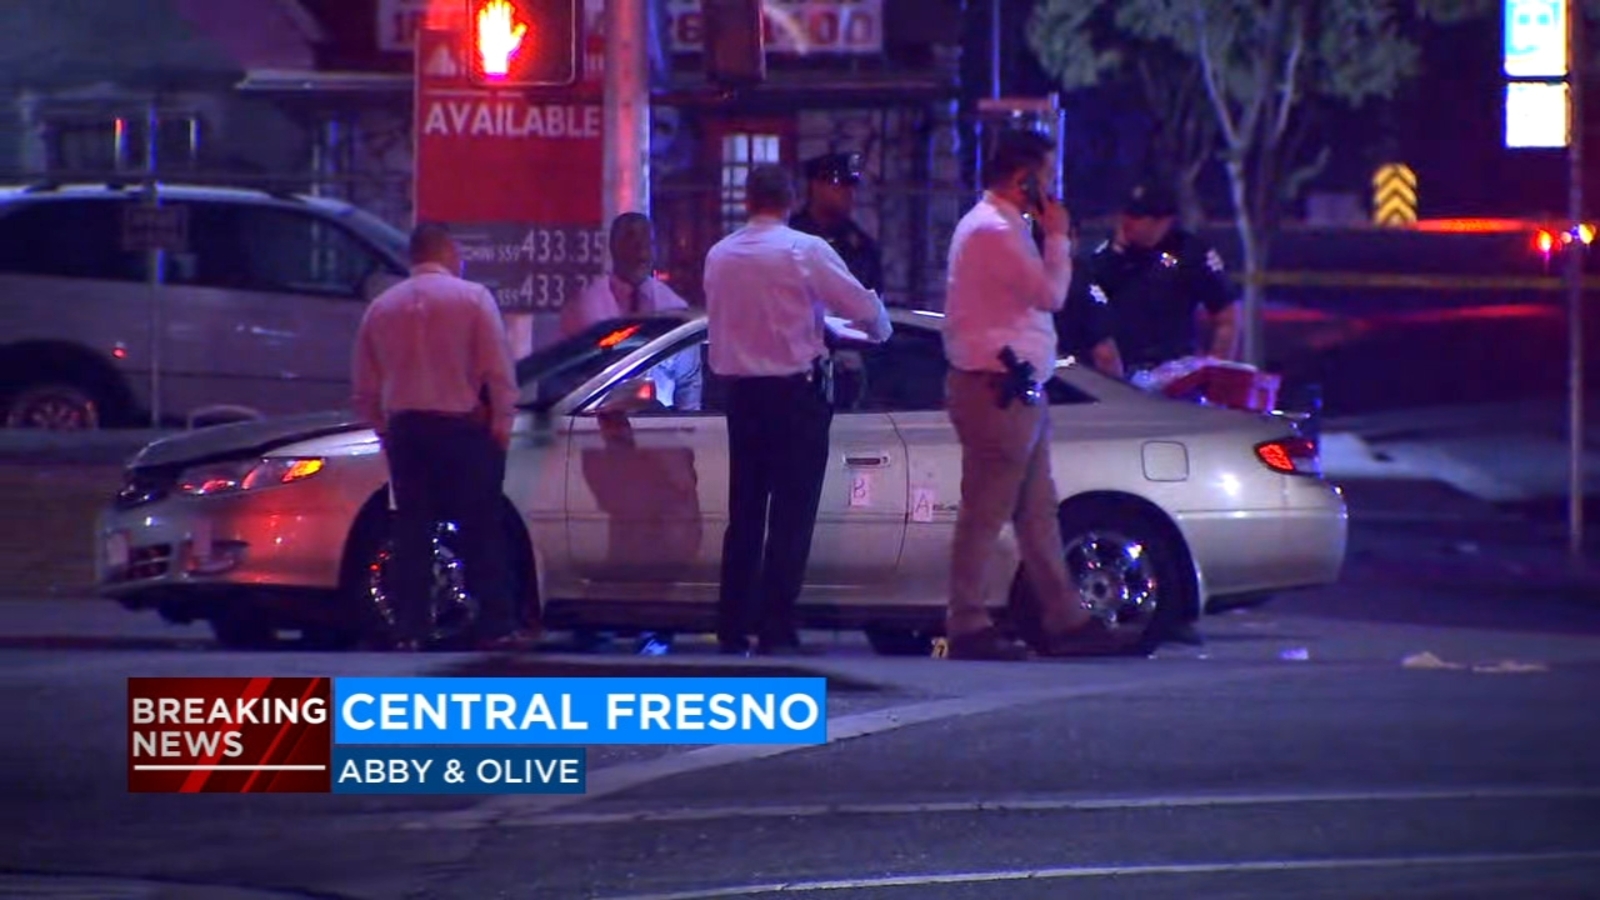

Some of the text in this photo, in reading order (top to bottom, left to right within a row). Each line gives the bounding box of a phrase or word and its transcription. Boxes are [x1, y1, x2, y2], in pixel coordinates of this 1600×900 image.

[424, 101, 600, 137] AVAILABLE
[521, 229, 606, 263] 433.35
[853, 478, 866, 498] B
[915, 492, 930, 514] A
